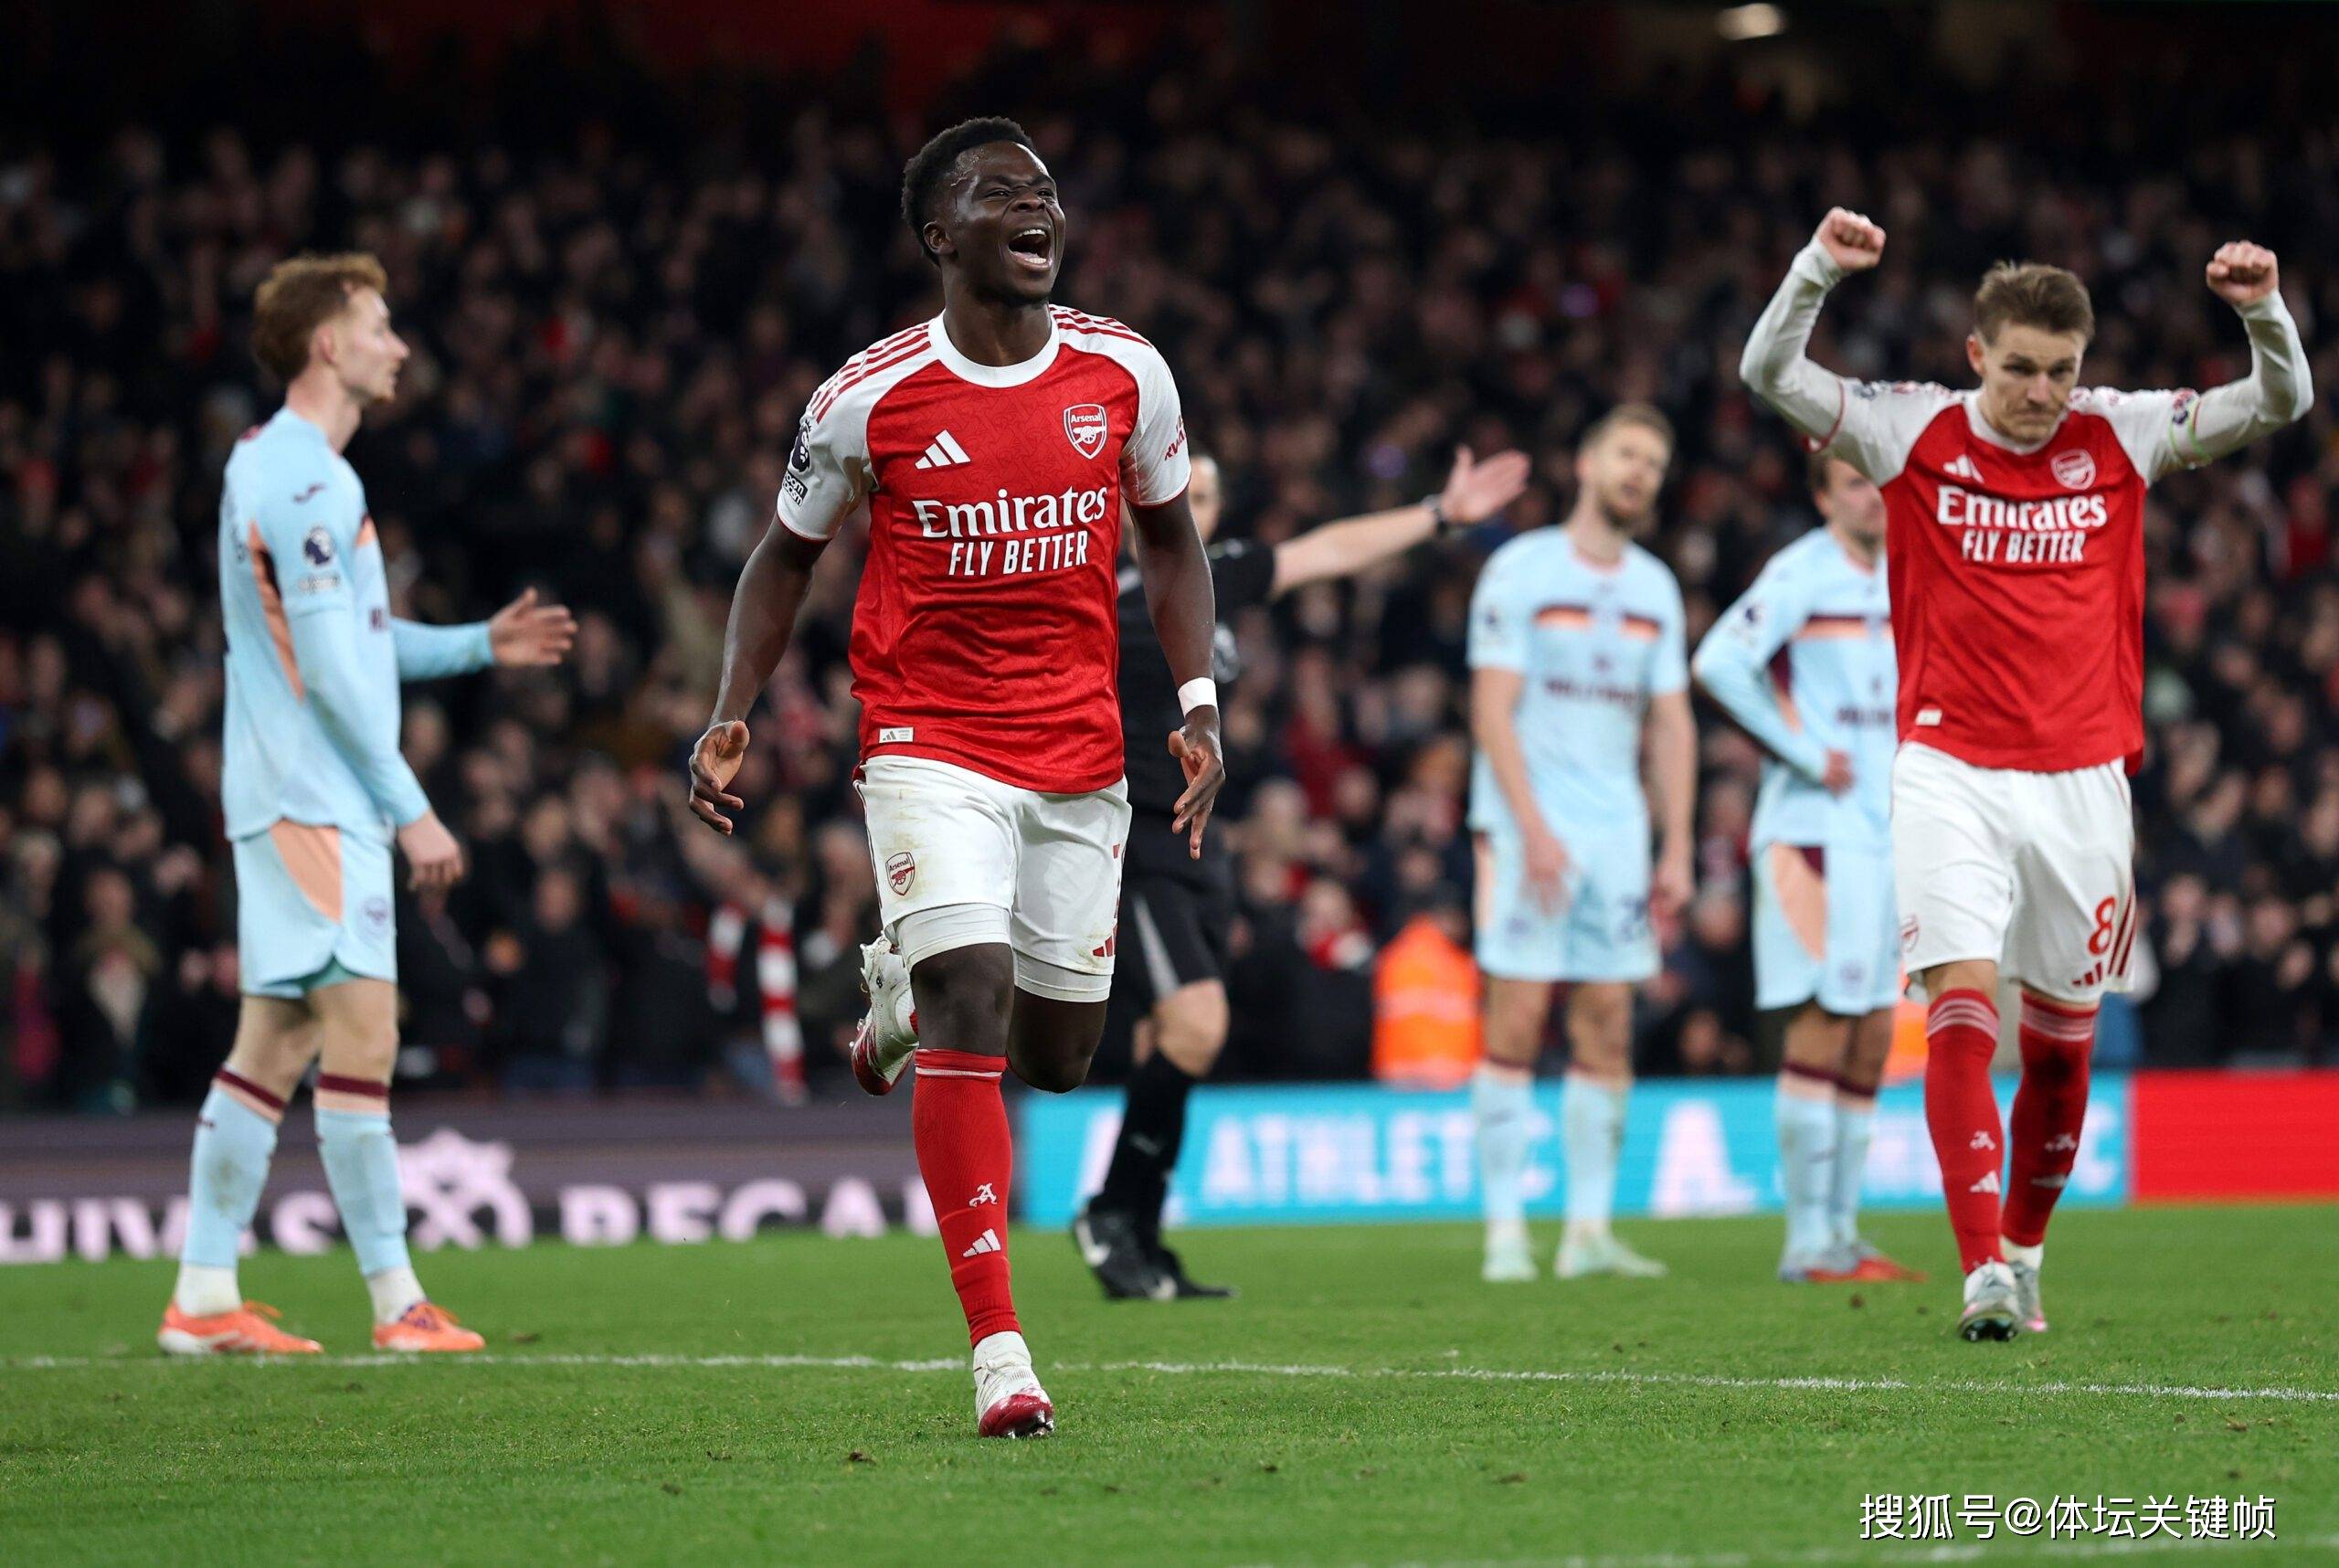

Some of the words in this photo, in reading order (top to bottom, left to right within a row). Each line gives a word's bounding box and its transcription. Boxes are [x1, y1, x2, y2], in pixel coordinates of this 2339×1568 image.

[1070, 413, 1102, 423] Arsenal
[912, 485, 1107, 538] Emirates
[1935, 484, 2108, 531] Emirates
[948, 541, 994, 576] FLY
[1003, 530, 1088, 575] BETTER
[1963, 530, 2003, 562] FLY
[2006, 530, 2086, 563] BETTER
[889, 858, 910, 871] Arsenal
[2087, 895, 2116, 955] 8
[1202, 1109, 1553, 1206] ATHLETC
